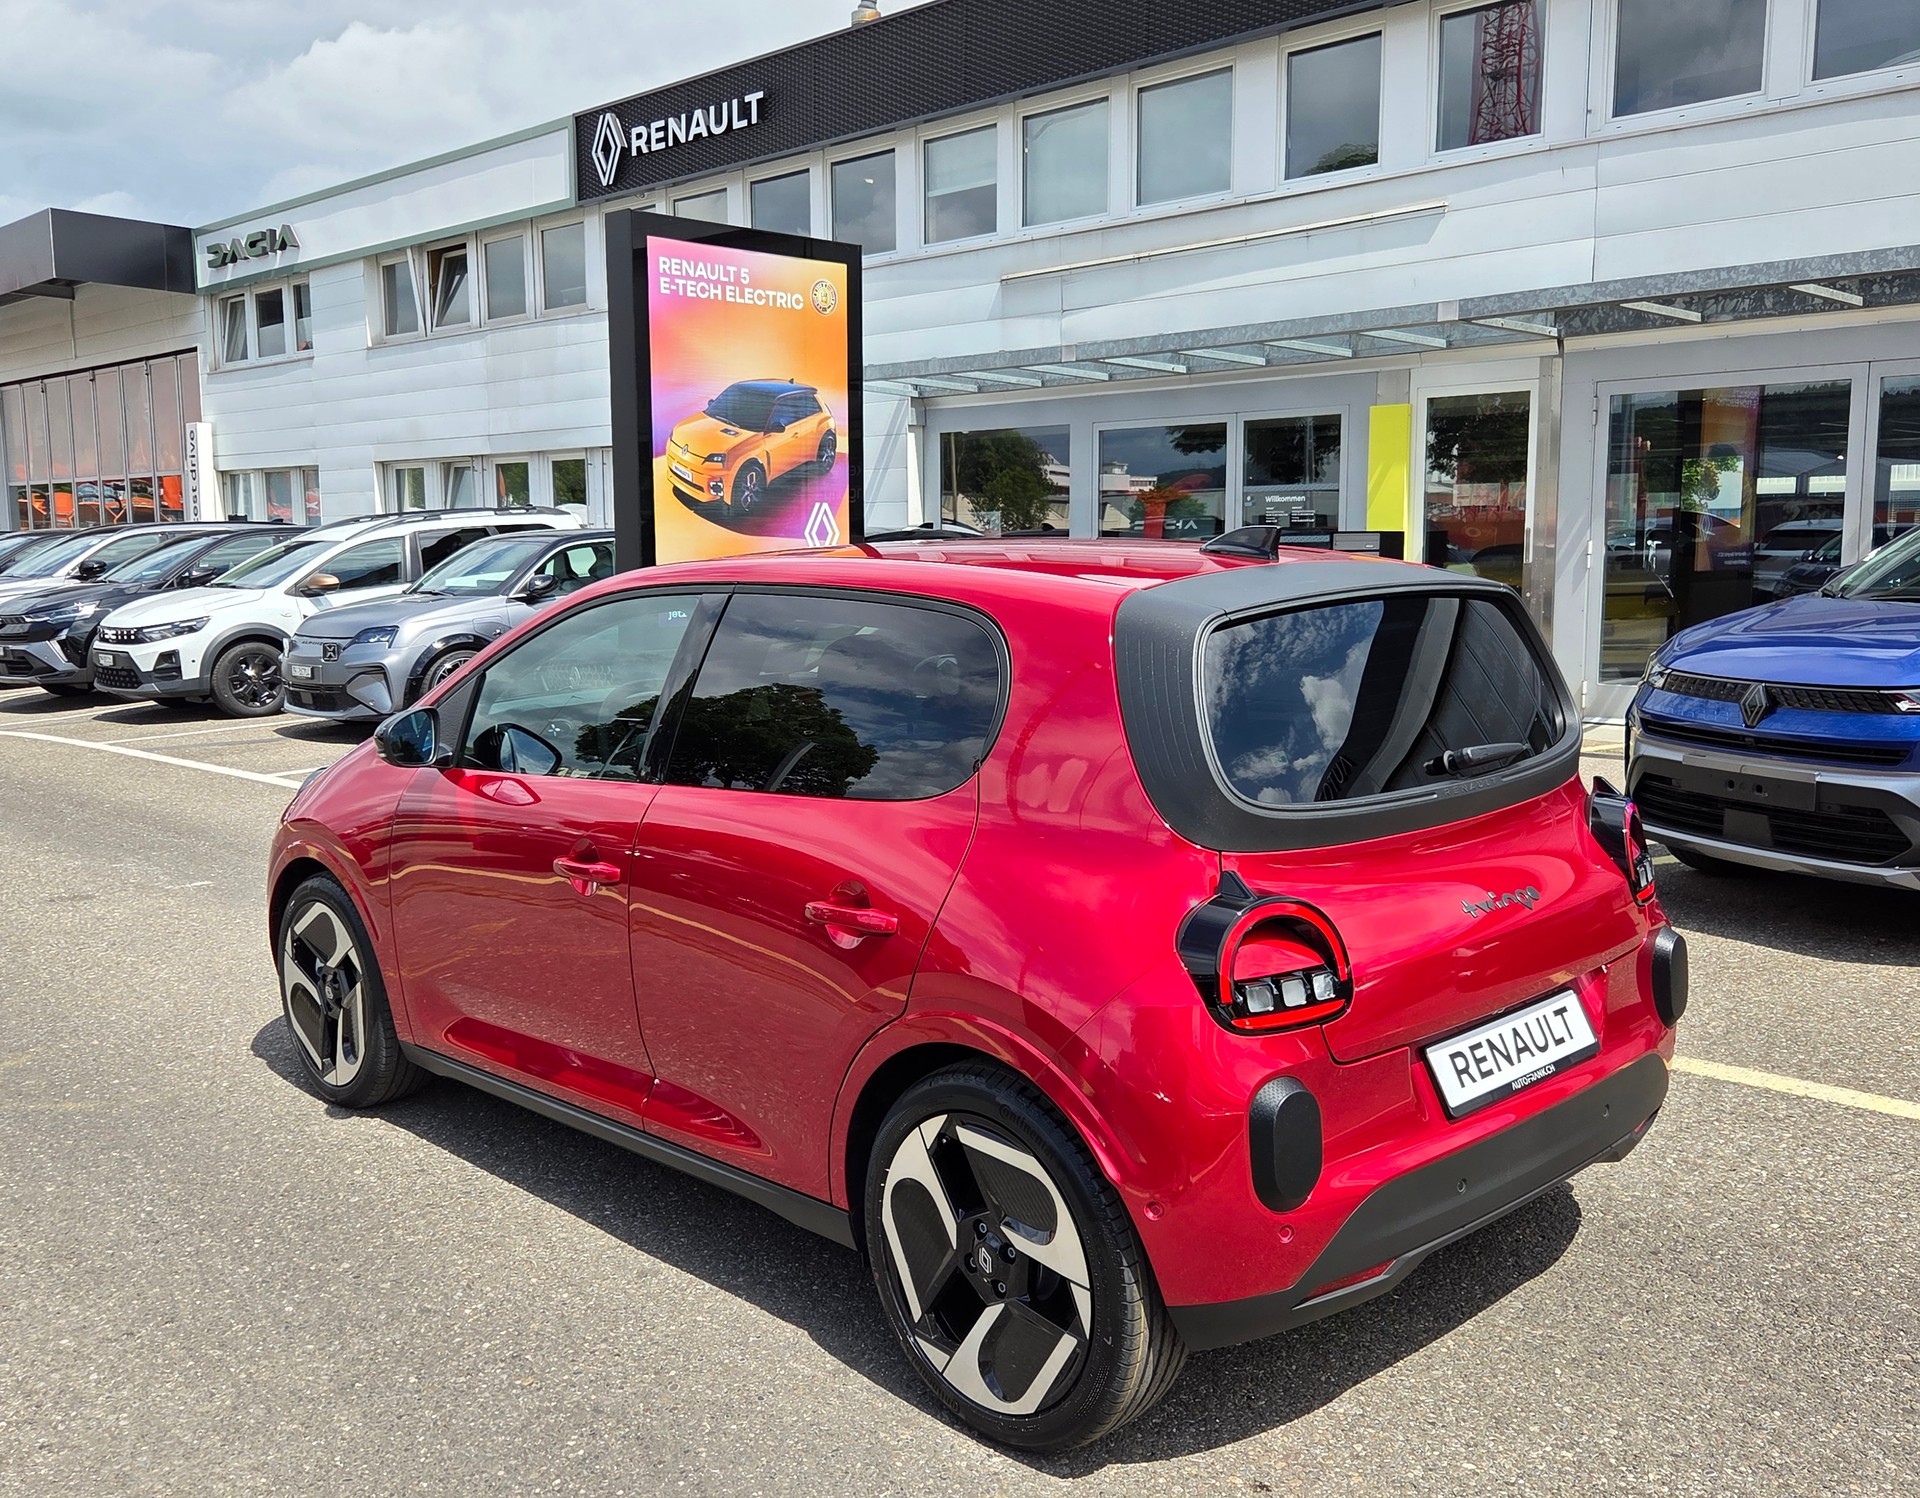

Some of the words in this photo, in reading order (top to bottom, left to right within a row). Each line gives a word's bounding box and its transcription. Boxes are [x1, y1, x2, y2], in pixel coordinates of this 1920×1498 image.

[631, 91, 764, 157] RENAULT
[206, 224, 300, 268] DACIA
[658, 256, 737, 283] RENAULT
[740, 268, 750, 285] 5
[659, 277, 722, 301] E-TECH
[725, 285, 804, 310] ELECTRIC
[1265, 495, 1306, 503] Willkommen
[1444, 777, 1498, 797] RENAULT
[1461, 885, 1540, 918] twingo
[1449, 1006, 1574, 1089] RENAULT
[1511, 1064, 1556, 1091] AUTOFRANK.CH
